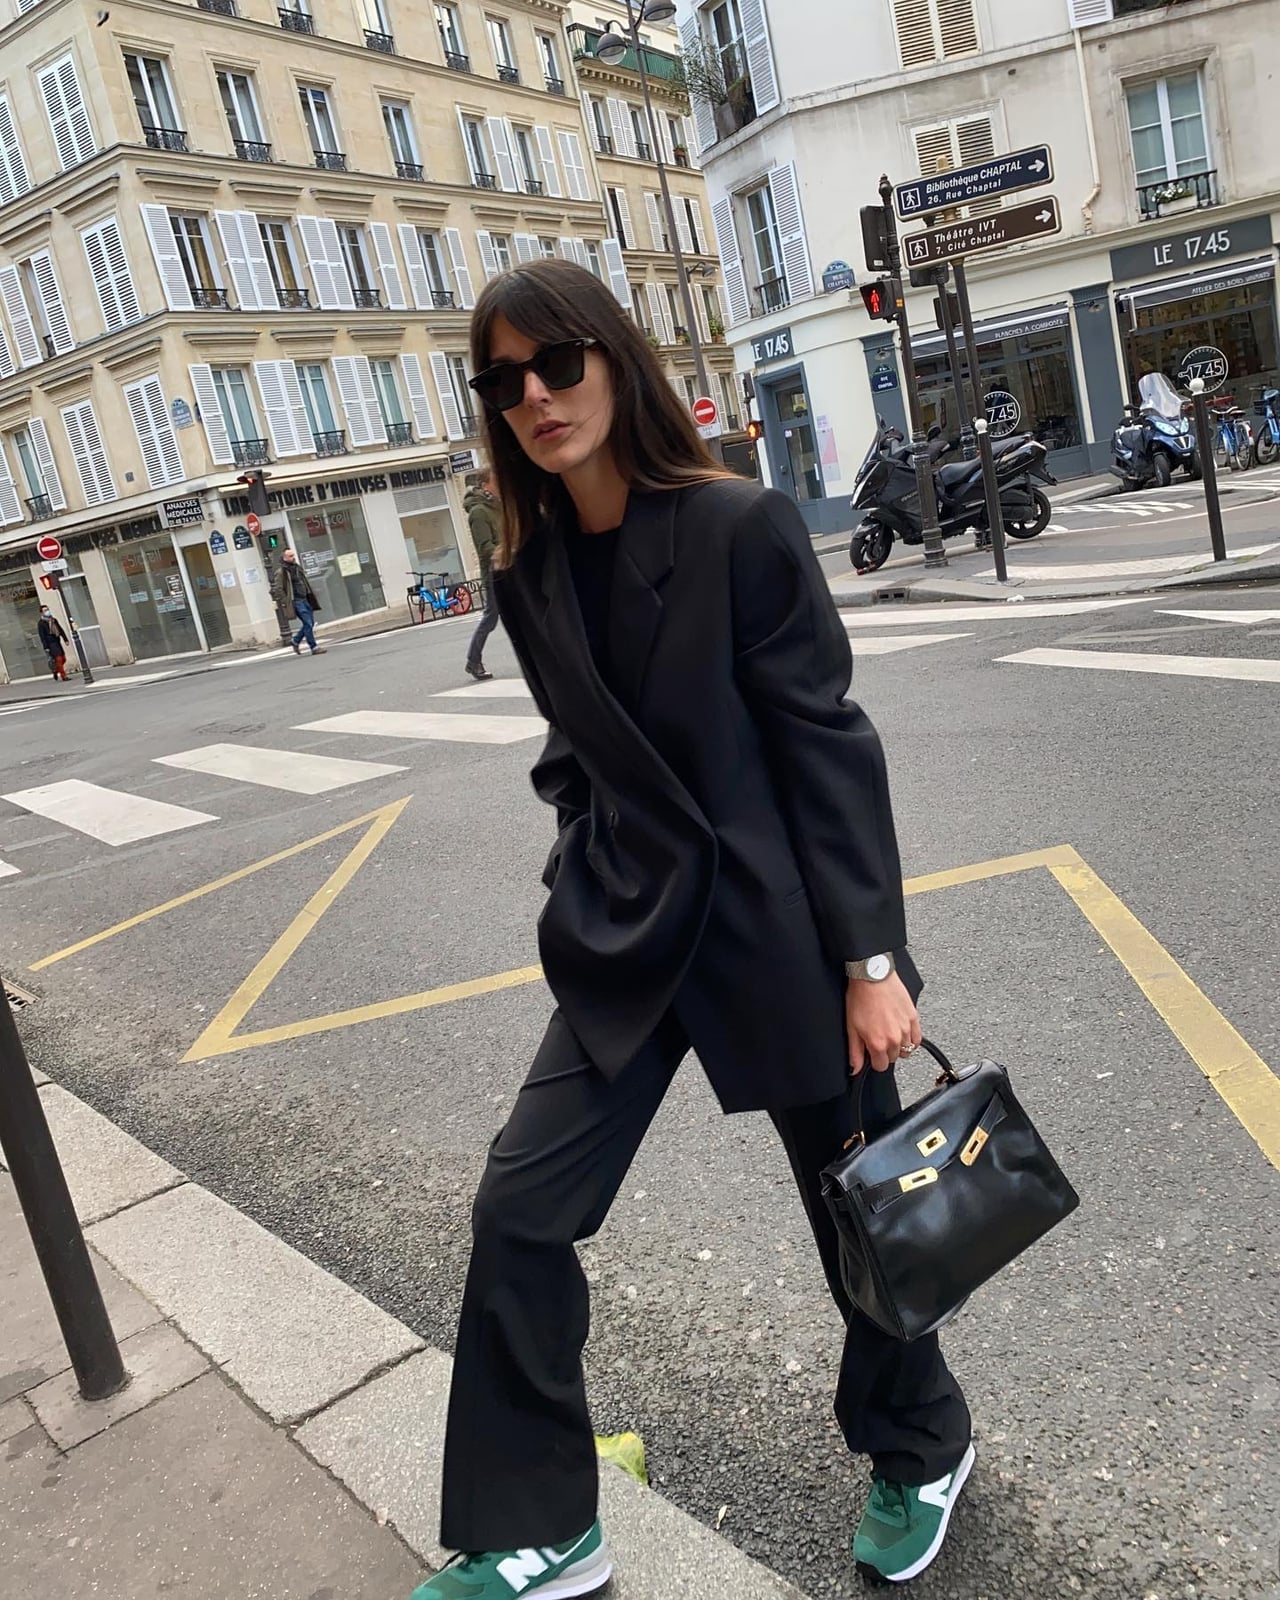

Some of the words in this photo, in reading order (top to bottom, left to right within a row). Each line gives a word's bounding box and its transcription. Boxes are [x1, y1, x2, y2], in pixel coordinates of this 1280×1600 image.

[926, 174, 978, 194] Bibliothèque
[980, 160, 1022, 179] CHAPTAL
[946, 191, 962, 200] Rue
[966, 179, 1001, 194] Chaptal
[934, 227, 974, 244] Théâtre
[979, 219, 997, 233] IVT
[947, 240, 966, 252] Cité
[970, 229, 1005, 246] Chaptal
[1153, 243, 1174, 266] LE
[1184, 229, 1231, 259] 17.45
[994, 328, 1023, 339] PLANCHES
[764, 333, 790, 358] 17.45
[1190, 360, 1223, 379] 17.45
[986, 404, 1016, 423] 7.45
[166, 499, 198, 511] ANALYSES
[166, 507, 202, 519] MEDICALES
[496, 1547, 550, 1594] N
